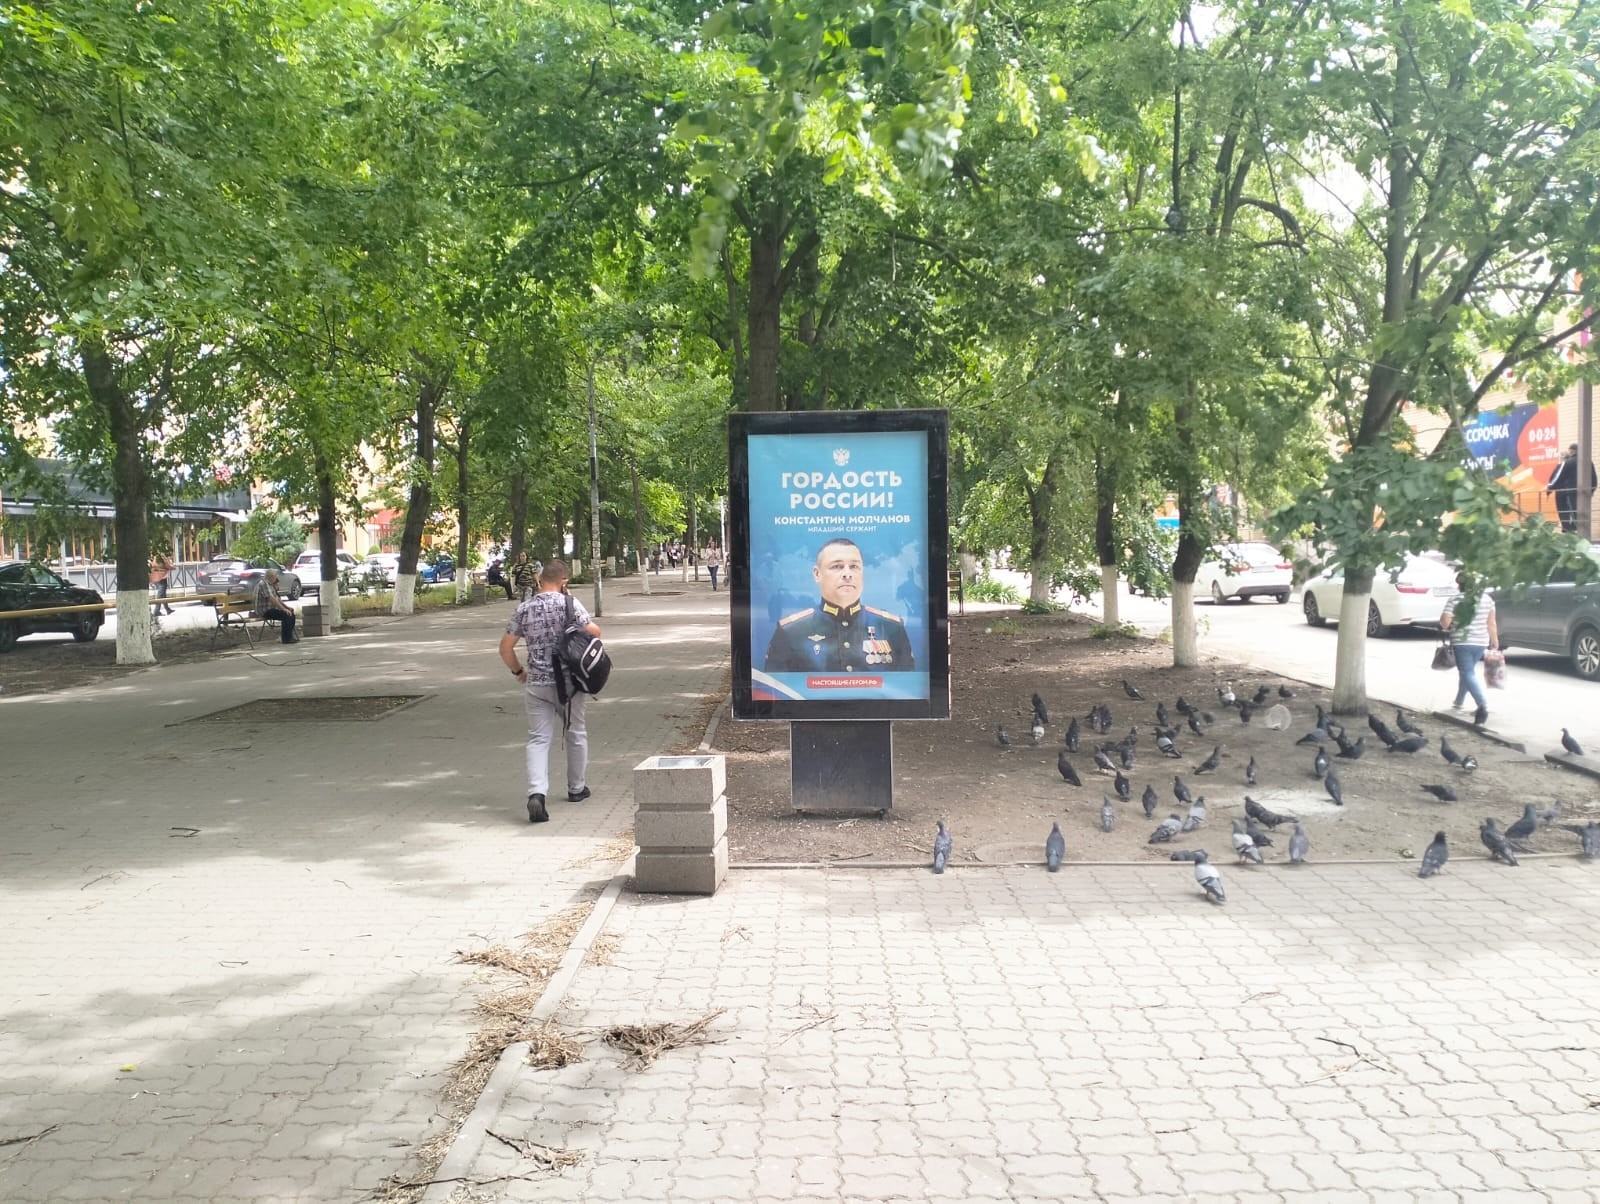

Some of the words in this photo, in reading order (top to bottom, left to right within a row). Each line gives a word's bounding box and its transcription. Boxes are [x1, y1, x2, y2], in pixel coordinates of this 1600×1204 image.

[1464, 424, 1510, 443] ССРОЧКА
[781, 471, 903, 490] ГОРДОСТЬ
[790, 492, 894, 510] РОССИИ!
[774, 516, 846, 526] КОНСТАНТИН
[848, 515, 911, 525] МОЛЧАНОВ
[808, 525, 845, 534] МЛАДШИЙ
[845, 525, 878, 534] СЕРЖАНТ
